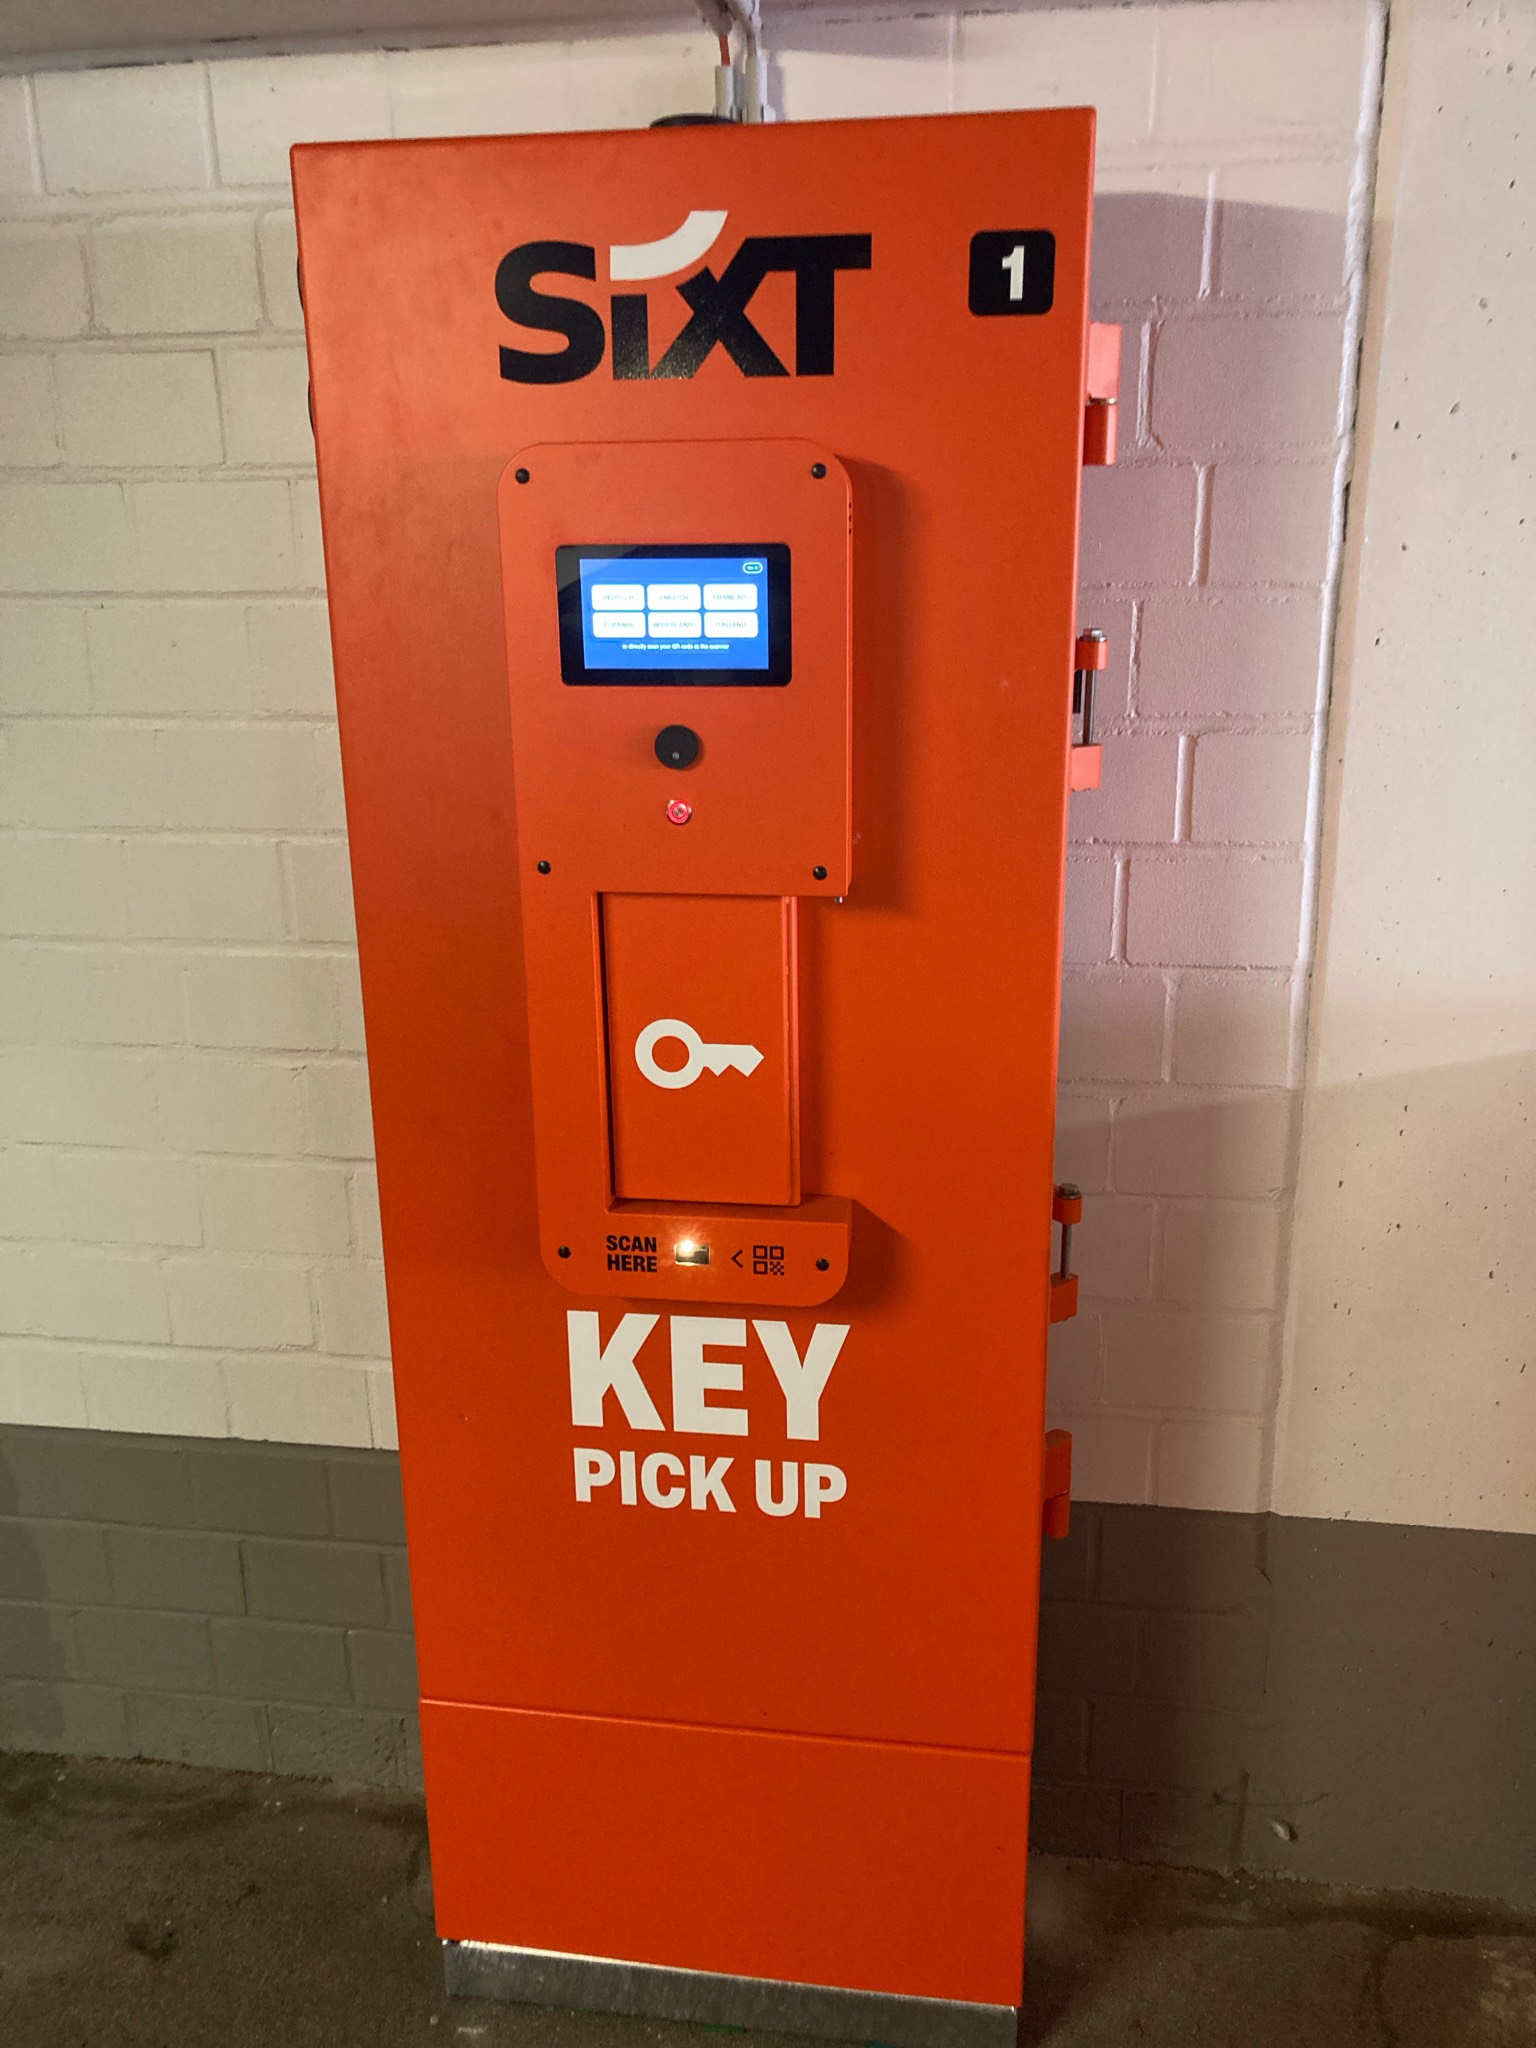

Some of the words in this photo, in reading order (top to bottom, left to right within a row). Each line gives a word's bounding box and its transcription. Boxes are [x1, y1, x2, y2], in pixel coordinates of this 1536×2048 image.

[1002, 244, 1026, 301] 1
[606, 1235, 657, 1254] SCAN
[607, 1254, 658, 1273] HERE
[567, 1310, 851, 1441] KEY
[573, 1447, 737, 1513] PICK
[755, 1459, 848, 1519] UP
